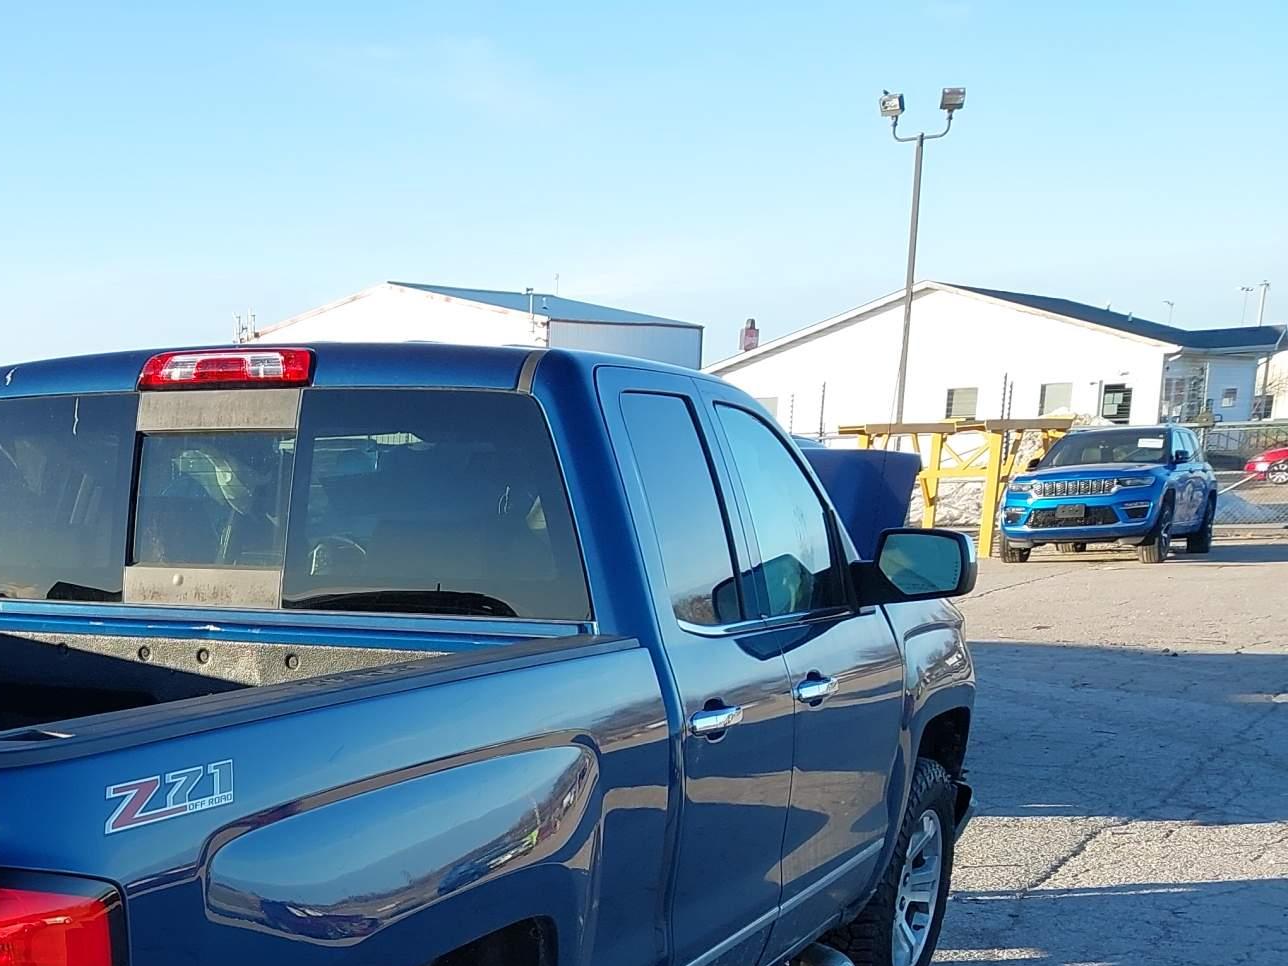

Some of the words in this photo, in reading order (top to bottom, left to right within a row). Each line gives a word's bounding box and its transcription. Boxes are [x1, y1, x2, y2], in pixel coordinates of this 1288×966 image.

[104, 758, 234, 835] Z71
[188, 801, 206, 811] OFF
[208, 793, 233, 806] ROAD
